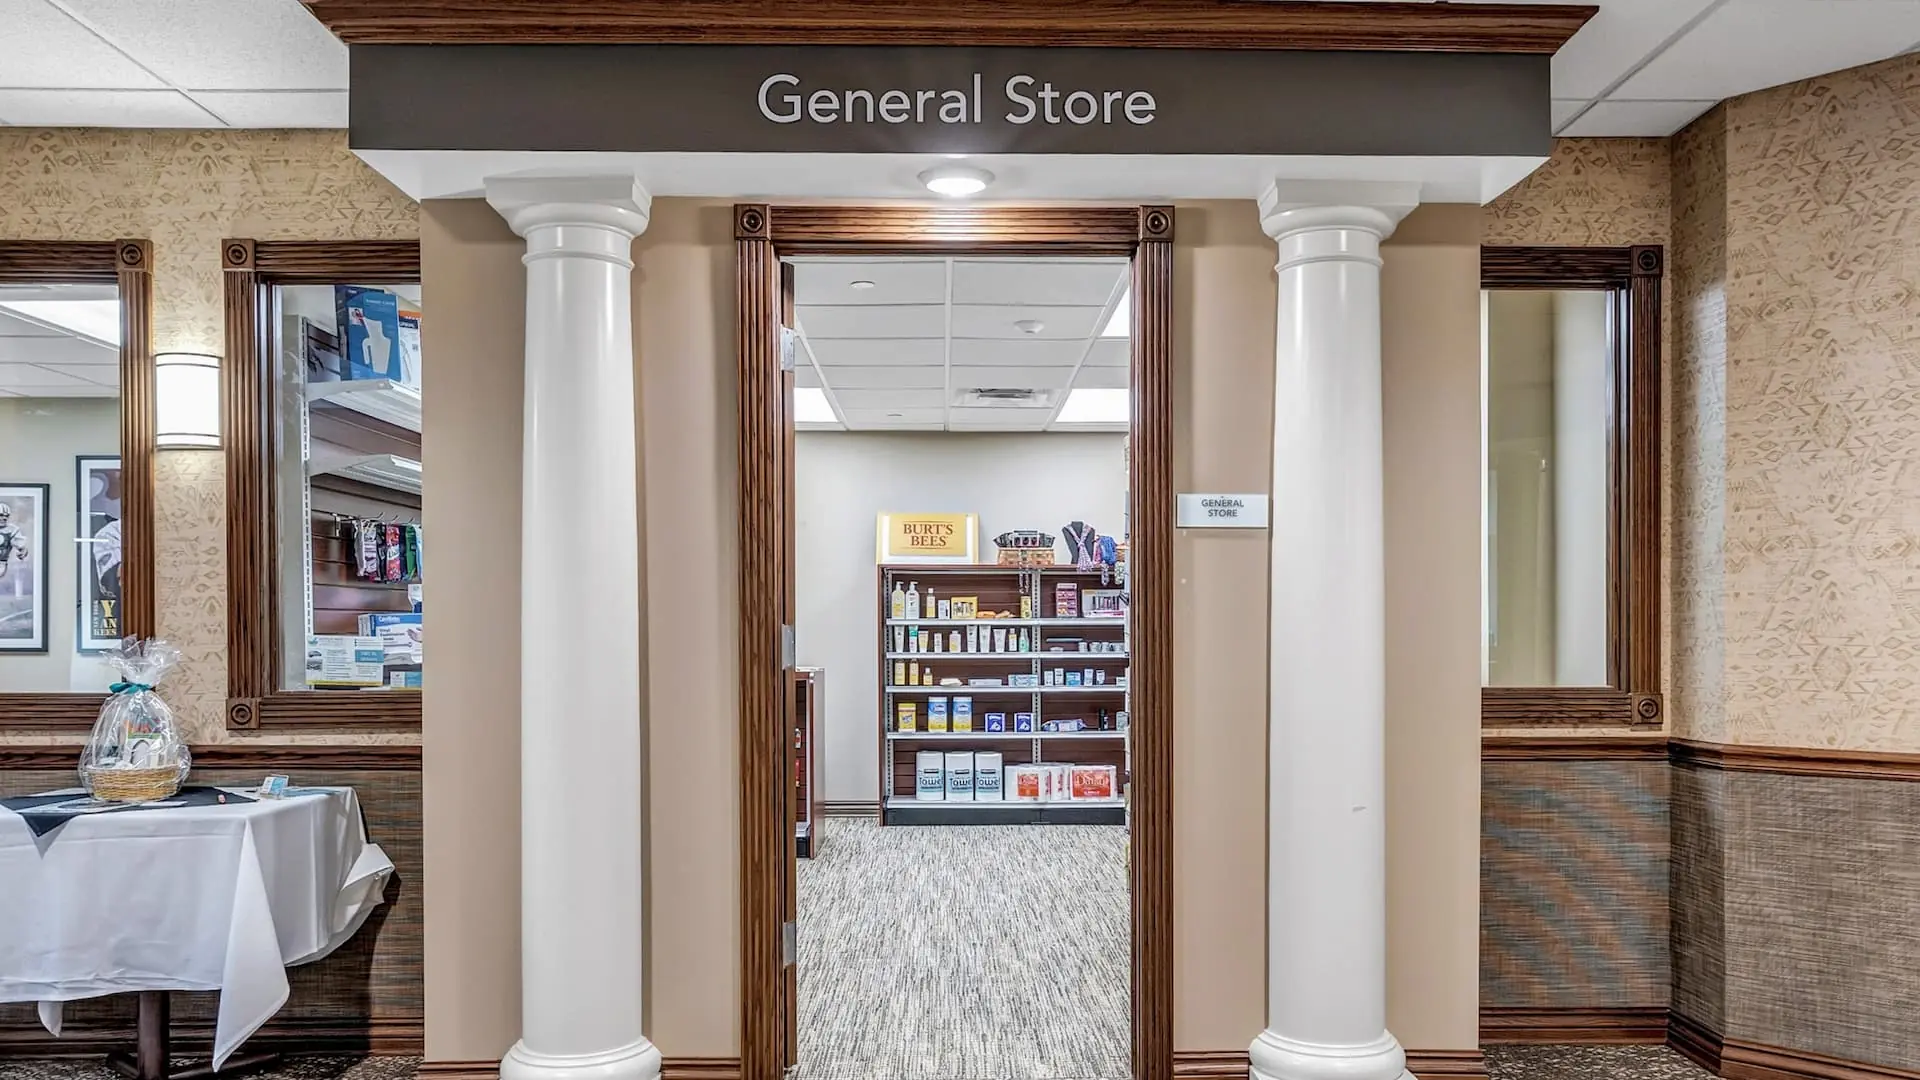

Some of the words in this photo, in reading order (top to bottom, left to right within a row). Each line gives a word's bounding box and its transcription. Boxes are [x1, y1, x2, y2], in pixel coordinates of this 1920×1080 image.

[757, 73, 982, 124] General
[1004, 74, 1157, 125] Store
[1201, 499, 1244, 508] GENERAL
[1208, 509, 1239, 517] STORE
[903, 523, 954, 535] BURT'S
[911, 535, 948, 547] BEES
